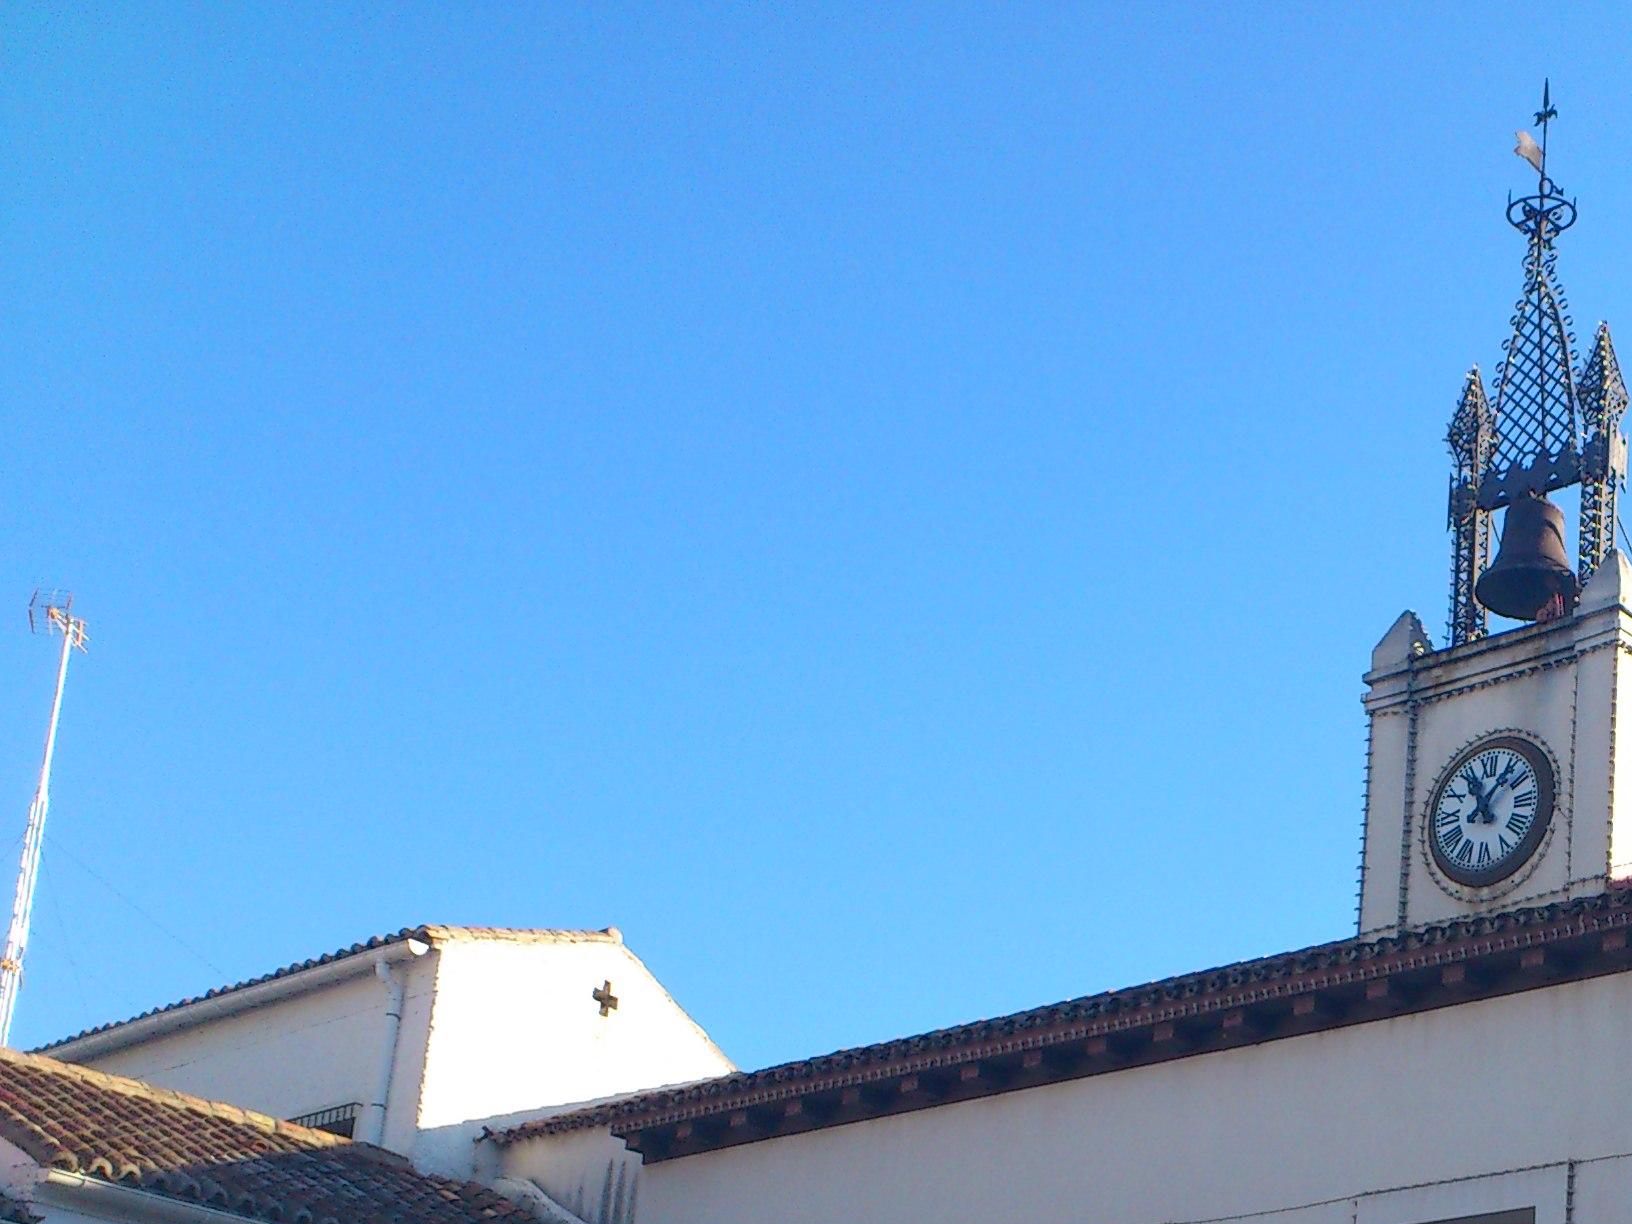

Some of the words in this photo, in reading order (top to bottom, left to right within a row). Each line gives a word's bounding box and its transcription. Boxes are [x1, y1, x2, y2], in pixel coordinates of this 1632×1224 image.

[1481, 755, 1498, 780] XII
[1510, 769, 1529, 790] II
[1447, 788, 1466, 804] X
[1514, 790, 1532, 808] III
[1478, 842, 1491, 863] VI
[1499, 834, 1511, 854] V
